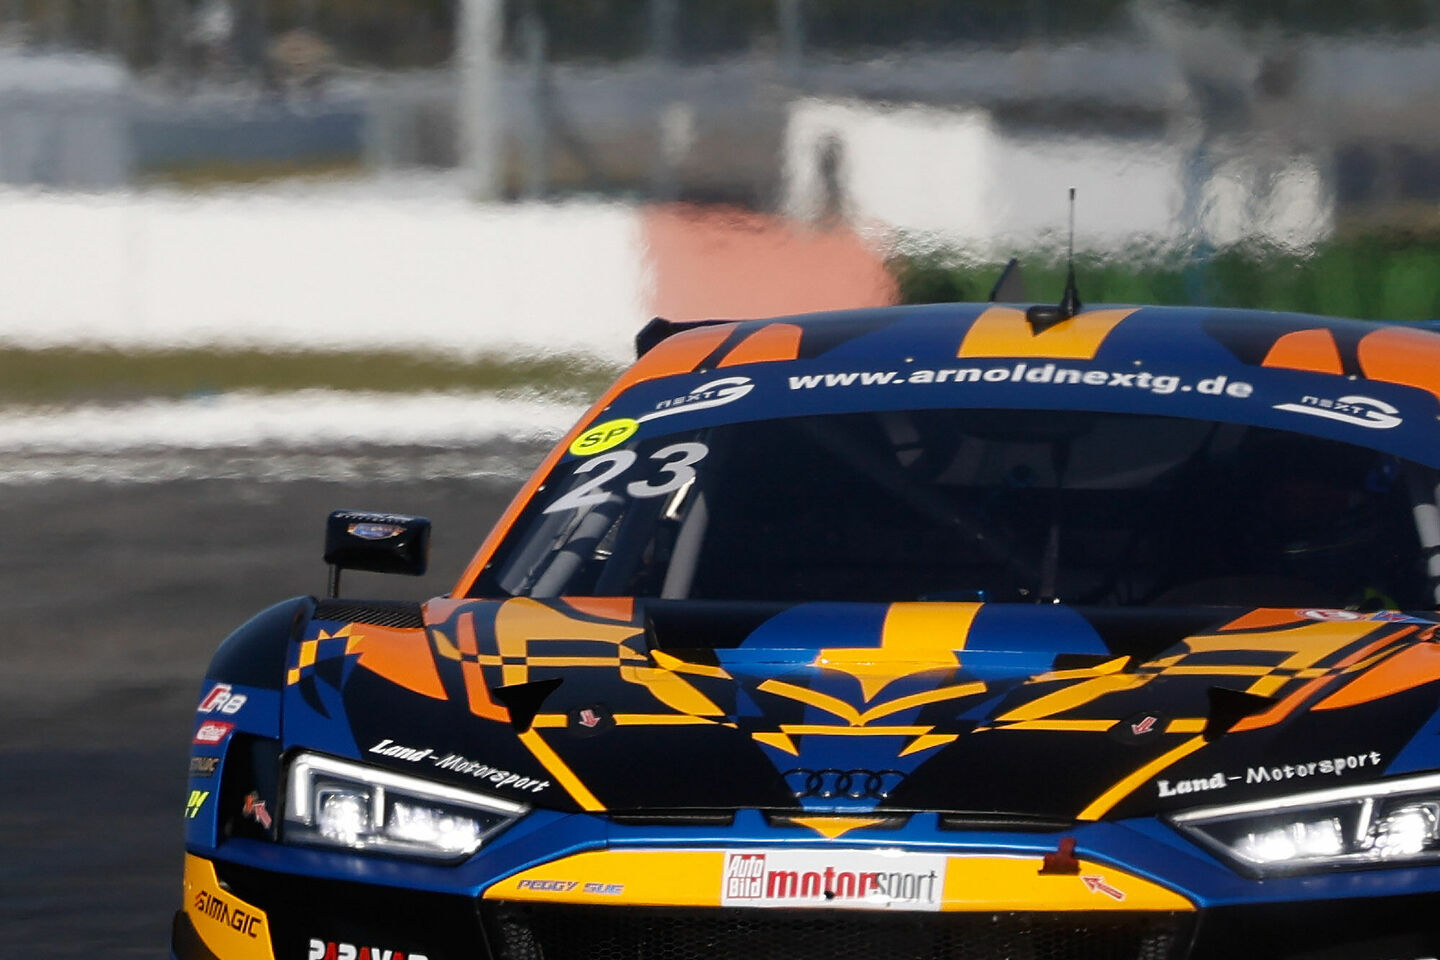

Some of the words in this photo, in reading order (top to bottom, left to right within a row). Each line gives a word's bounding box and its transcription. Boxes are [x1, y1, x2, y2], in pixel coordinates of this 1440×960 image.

[788, 363, 1254, 399] www.arnoldnextg.de
[579, 427, 629, 448] SP
[543, 442, 709, 515] 23
[204, 687, 248, 714] R8
[730, 855, 764, 878] Auto
[517, 880, 579, 892] PEGGY
[582, 882, 625, 896] SUE
[728, 878, 763, 898] Bild
[195, 890, 262, 938] SIMAGIC
